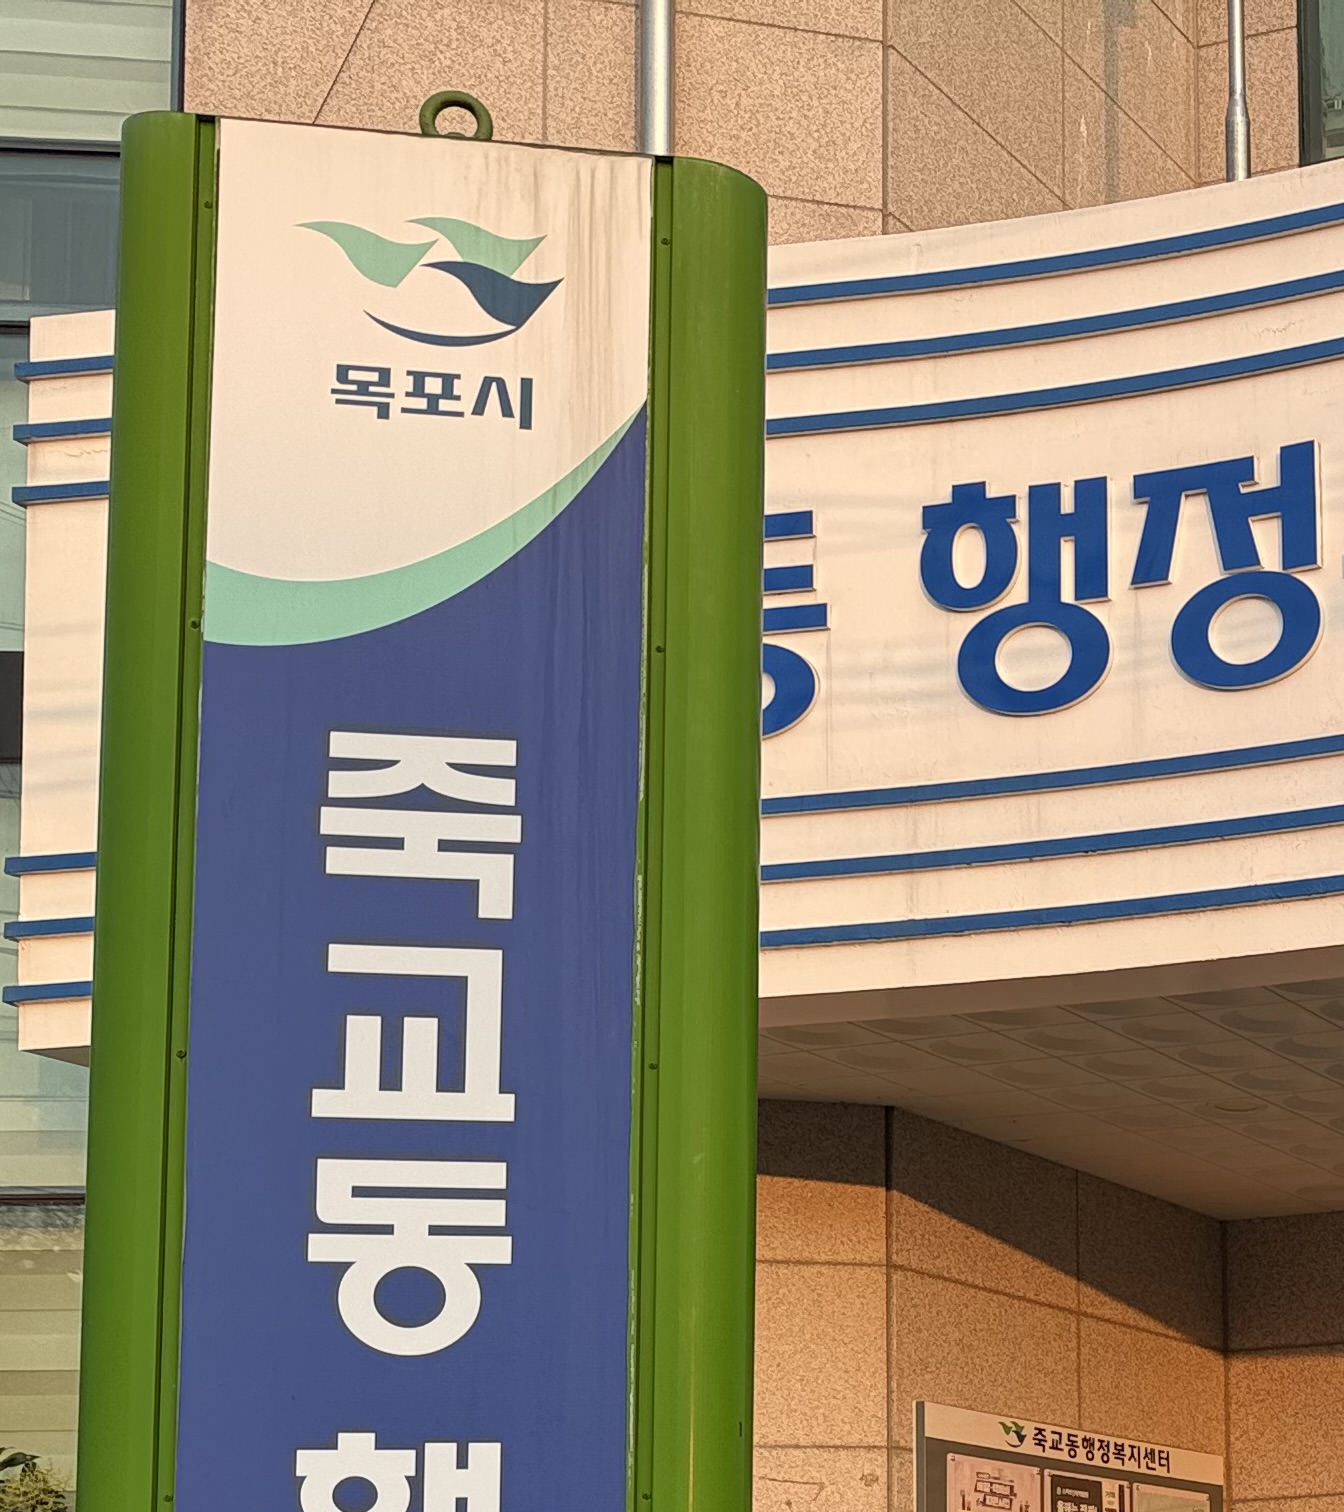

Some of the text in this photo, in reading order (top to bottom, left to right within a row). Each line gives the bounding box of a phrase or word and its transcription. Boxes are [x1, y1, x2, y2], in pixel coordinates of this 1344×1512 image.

[330, 363, 534, 431] 목포시
[308, 729, 522, 1357] 죽교동
[1032, 1427, 1172, 1474] 죽교동행정복지센터
